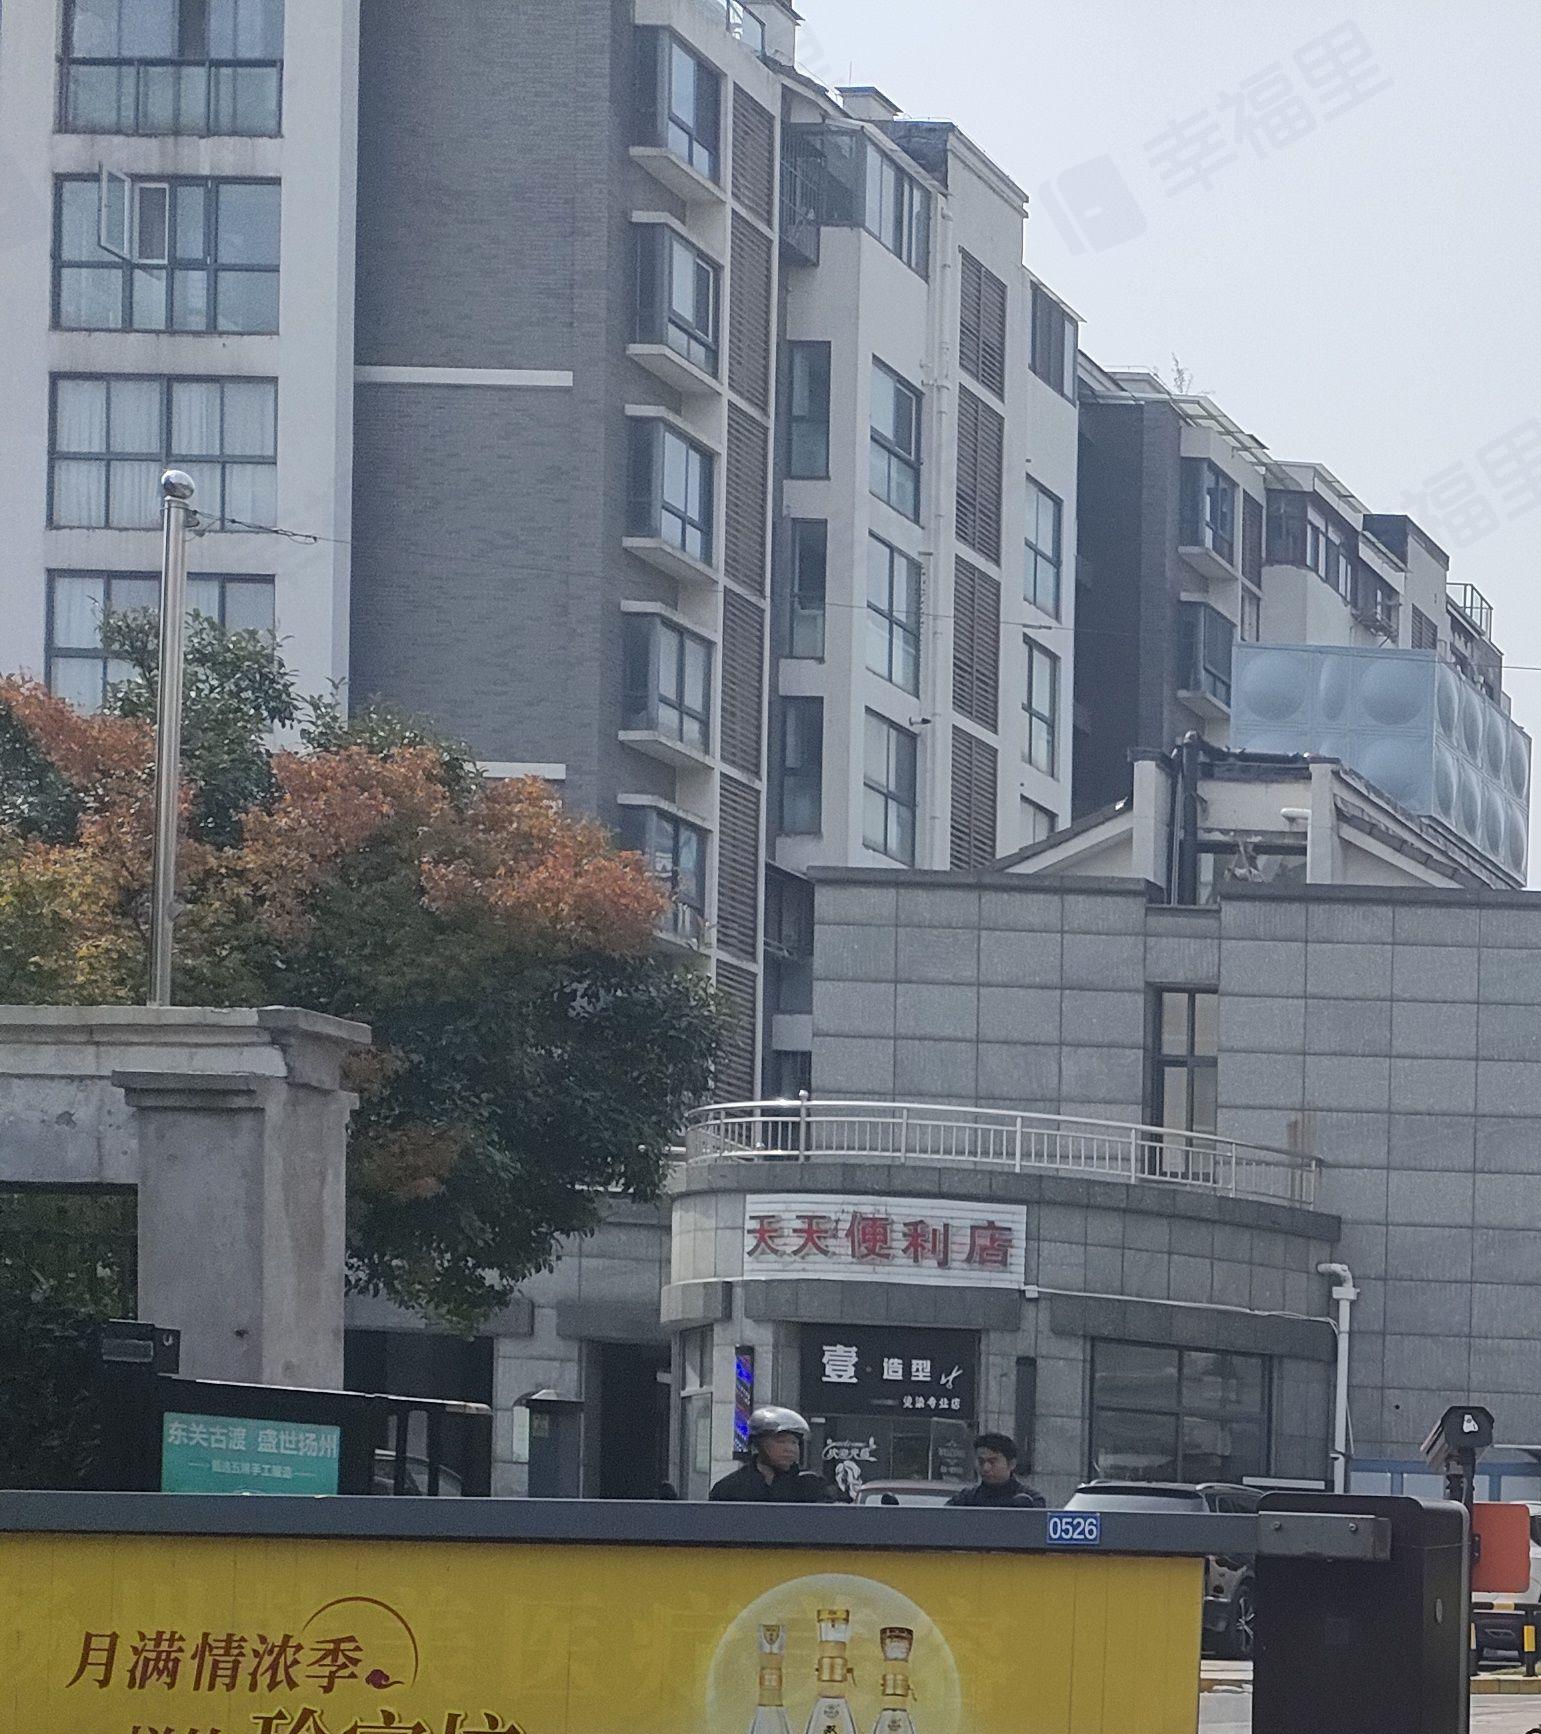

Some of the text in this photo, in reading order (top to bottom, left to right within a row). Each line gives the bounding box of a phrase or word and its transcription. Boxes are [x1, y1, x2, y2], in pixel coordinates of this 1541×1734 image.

[747, 1212, 1012, 1267] 天天便利店
[167, 1421, 338, 1459] 东关古渡 盛世扬州
[1049, 1517, 1097, 1540] 0526
[67, 1631, 364, 1694] 月满情浓季
